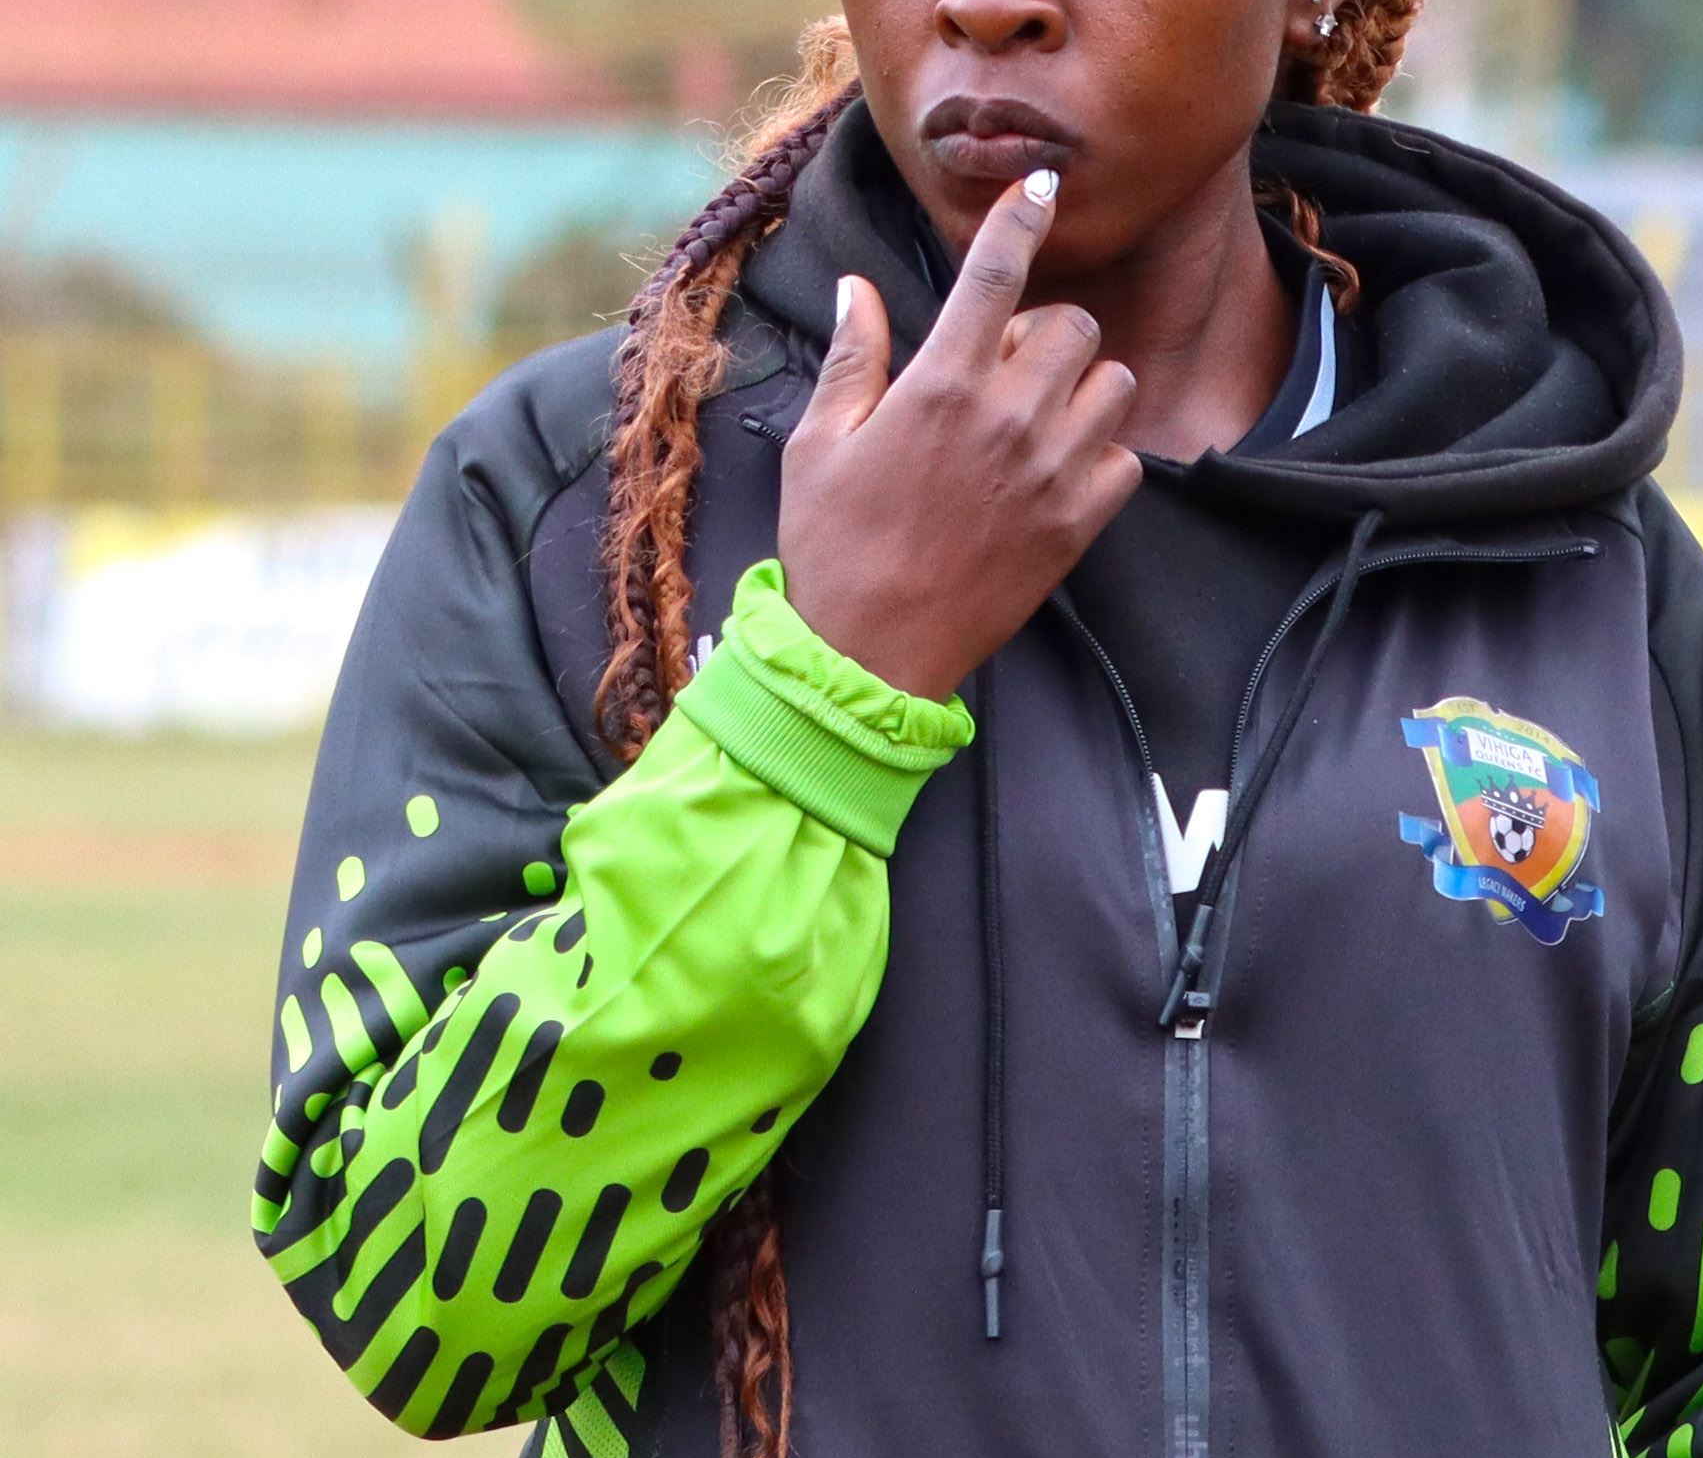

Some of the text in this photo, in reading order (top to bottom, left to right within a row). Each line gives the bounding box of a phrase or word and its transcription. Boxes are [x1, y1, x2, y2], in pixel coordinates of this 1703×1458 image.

[1475, 749, 1543, 779] QUEENS FC
[1476, 732, 1534, 765] VIHIGA
